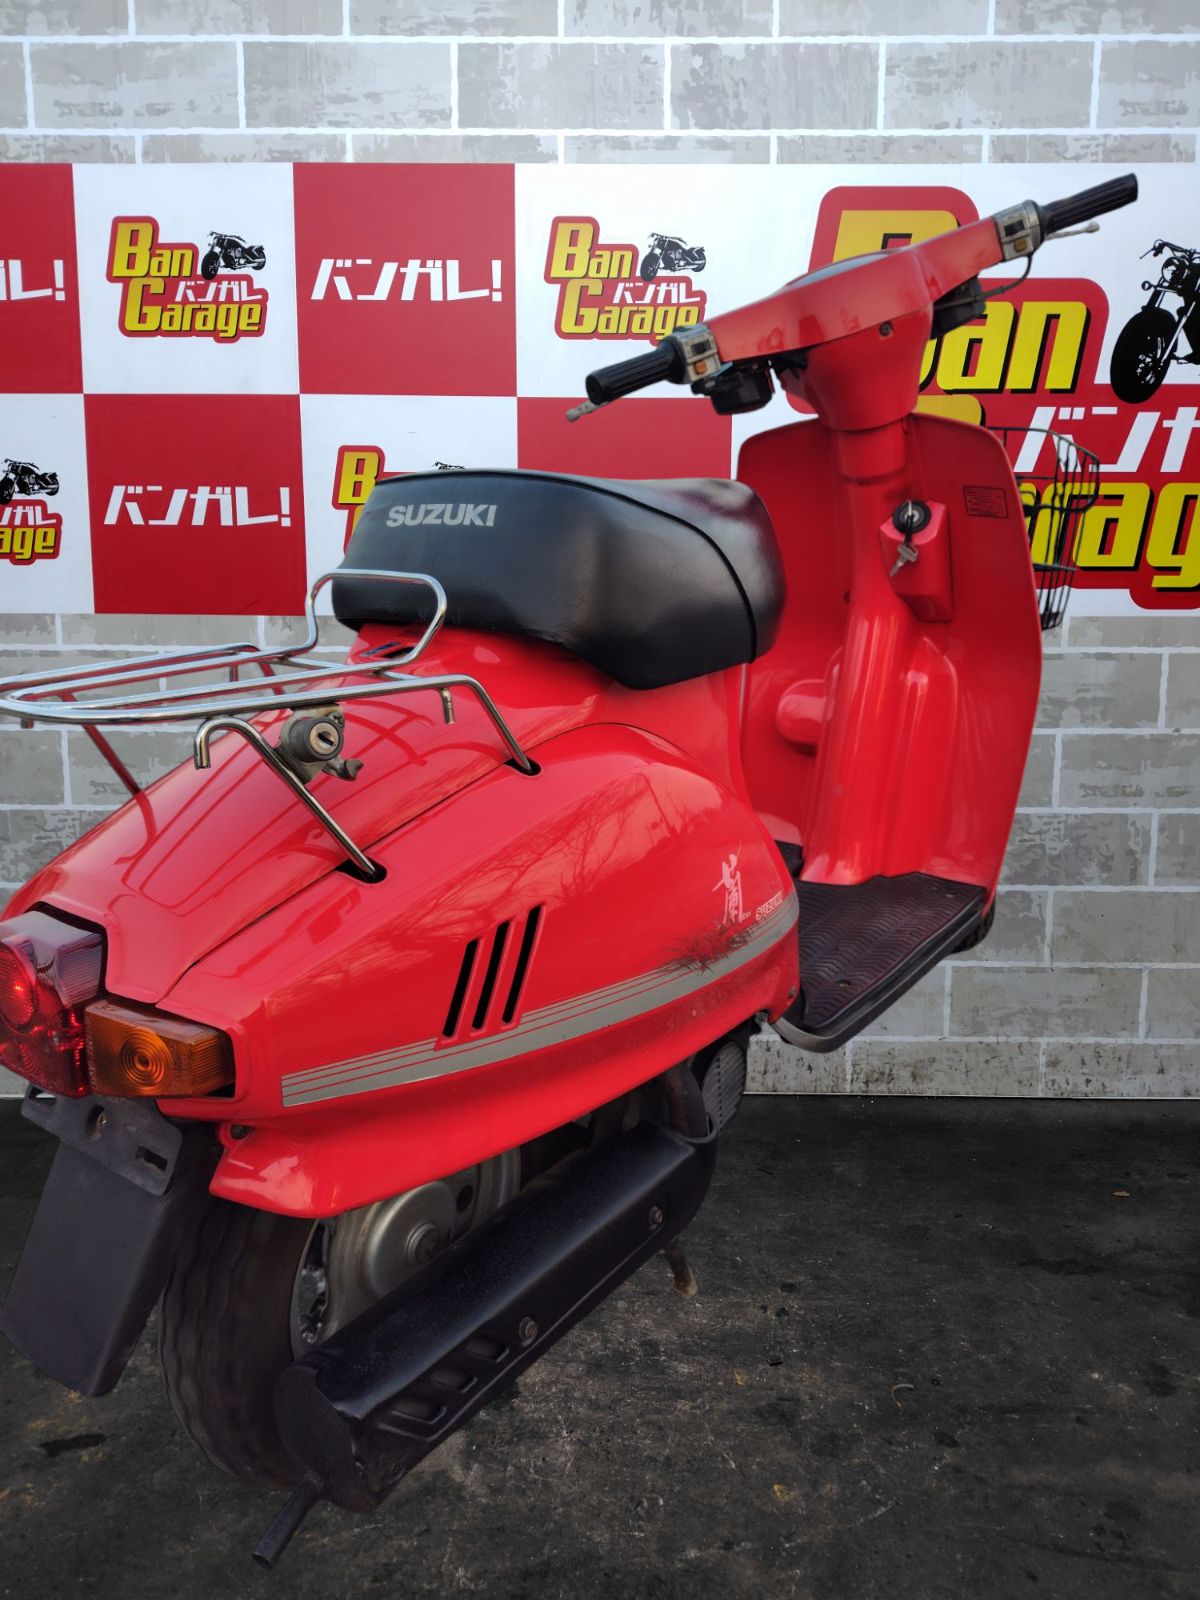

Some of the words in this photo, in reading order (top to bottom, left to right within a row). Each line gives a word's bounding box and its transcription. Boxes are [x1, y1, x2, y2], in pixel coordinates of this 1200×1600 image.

[112, 222, 195, 278] Ban
[550, 223, 633, 279] Ban
[0, 259, 66, 301] レ!
[174, 280, 263, 302] バンガレ
[310, 258, 503, 302] バンガレ!
[612, 282, 701, 304] バンガレ
[124, 277, 262, 339] Garage
[560, 278, 700, 341] Garage
[103, 485, 292, 527] バンガレ!
[386, 503, 498, 528] SUZUKI
